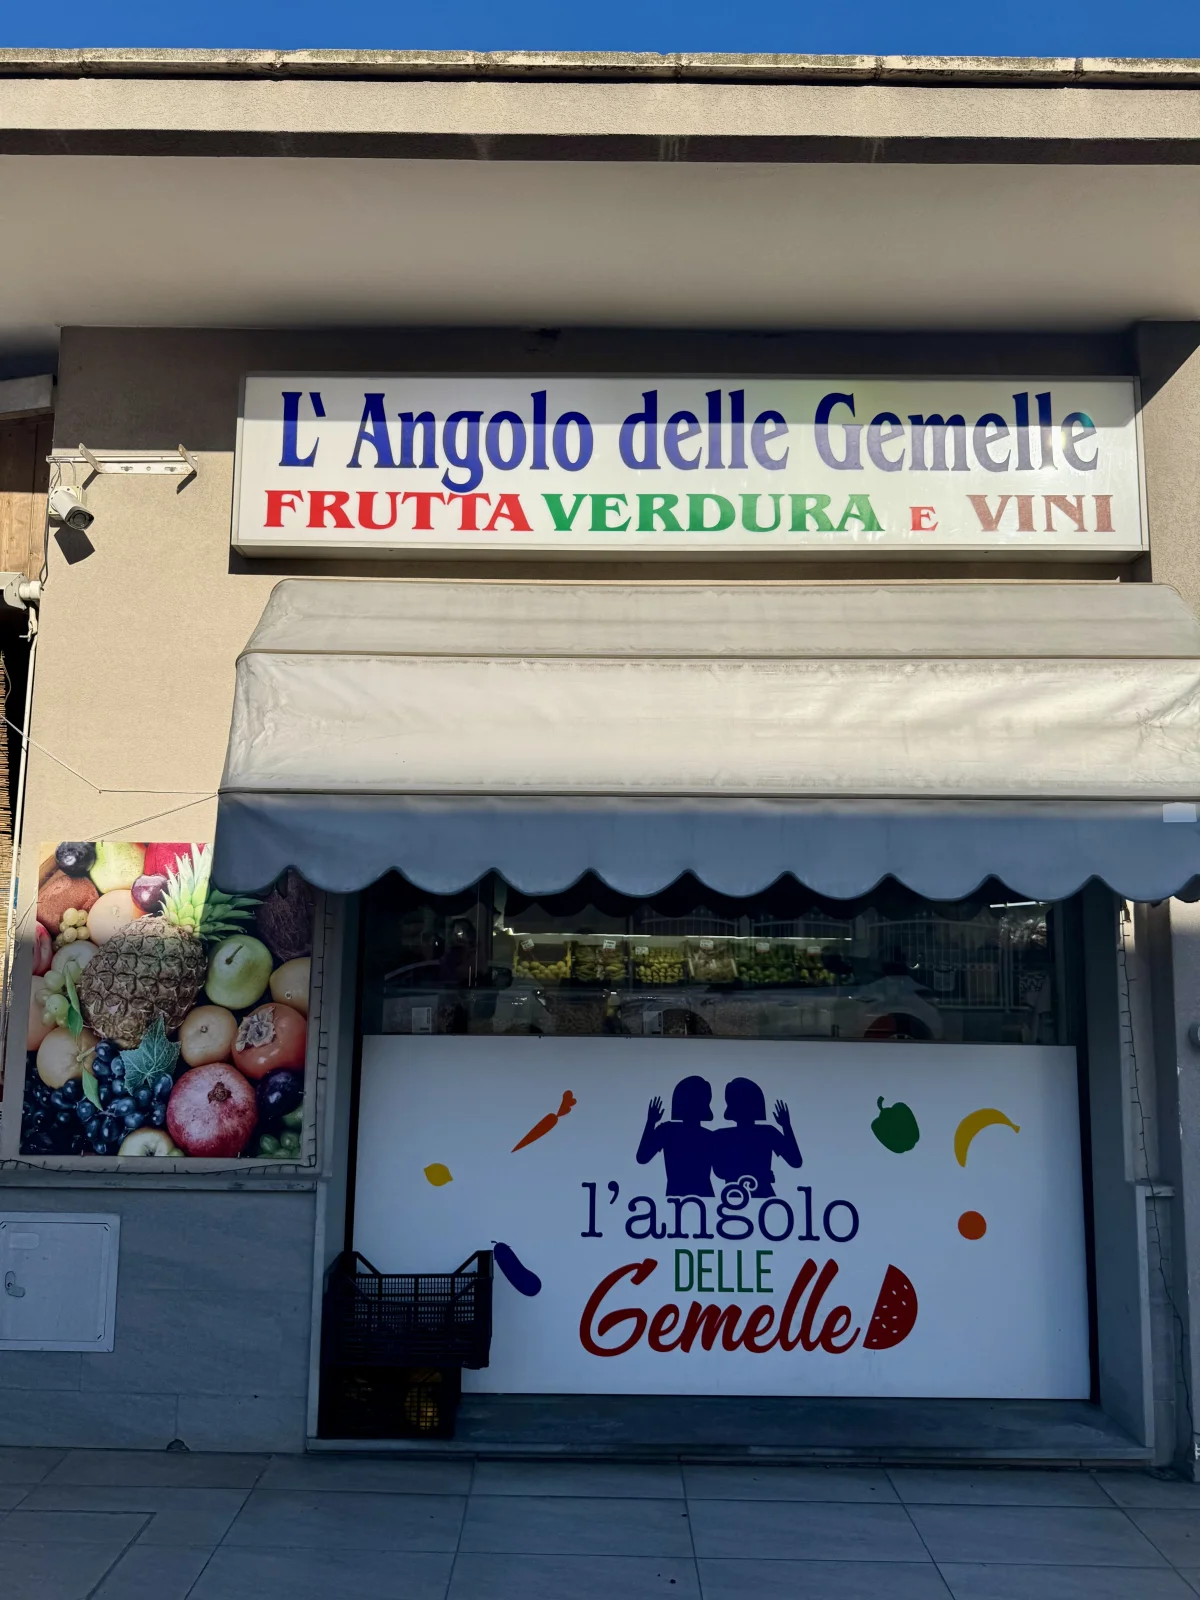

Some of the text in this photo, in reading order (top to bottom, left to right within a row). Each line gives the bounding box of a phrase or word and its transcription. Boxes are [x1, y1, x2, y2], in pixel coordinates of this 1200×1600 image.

[618, 388, 790, 471] delle
[814, 391, 1099, 472] Gemelle
[263, 489, 1116, 533] FRUTTA VERDURA E VINI
[580, 1175, 860, 1243] l'angolo
[674, 1249, 774, 1293] DELLE
[579, 1258, 861, 1357] Gemelle
